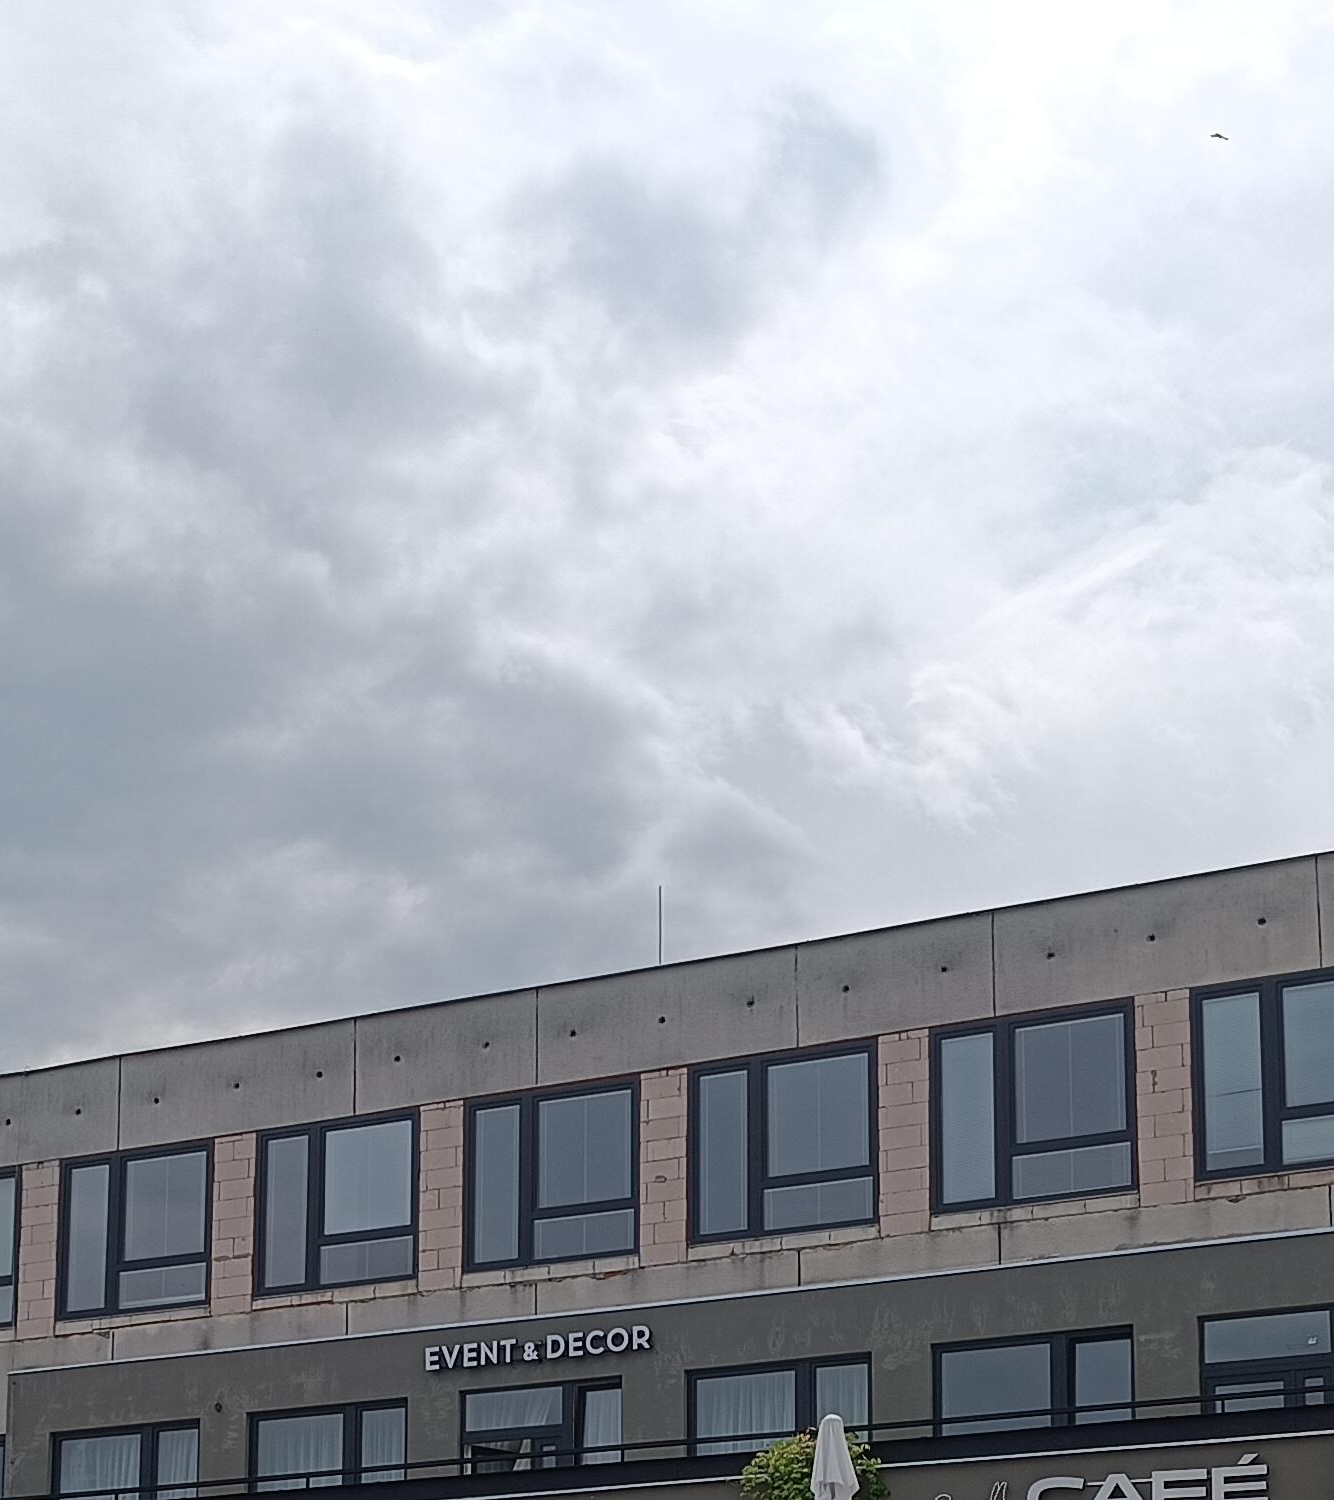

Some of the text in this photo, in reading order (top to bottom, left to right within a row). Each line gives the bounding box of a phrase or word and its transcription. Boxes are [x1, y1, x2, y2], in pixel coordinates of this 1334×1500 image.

[424, 1325, 652, 1371] EVENT & DECOR
